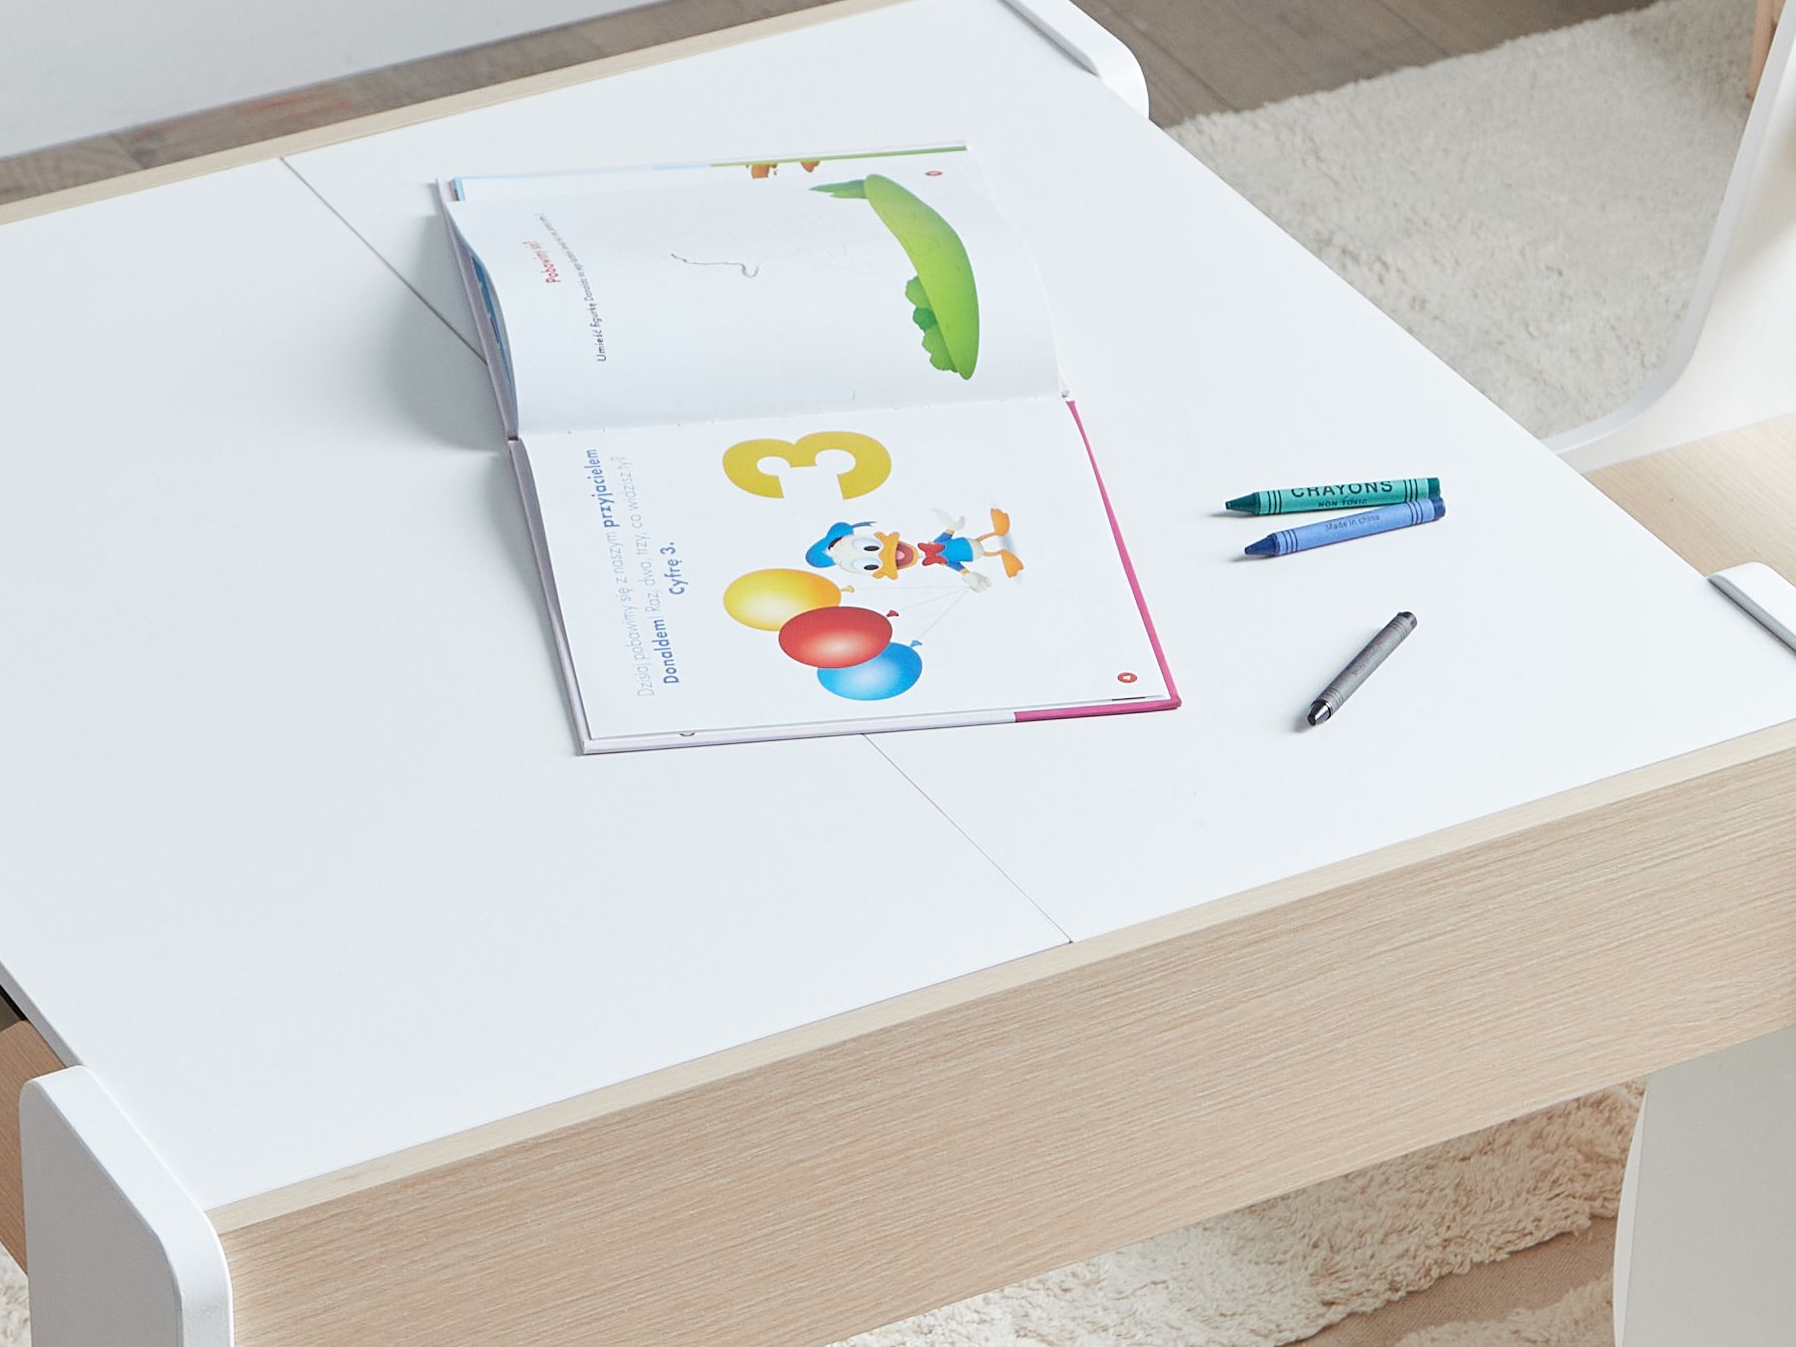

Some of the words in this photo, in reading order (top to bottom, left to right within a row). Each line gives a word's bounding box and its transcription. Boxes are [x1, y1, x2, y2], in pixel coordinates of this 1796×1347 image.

[722, 430, 892, 499] 3
[584, 448, 620, 528] przyjacielem
[1291, 480, 1393, 498] CRAYONS
[630, 514, 643, 529] co
[1325, 520, 1347, 530] Made
[1349, 519, 1355, 527] in
[659, 541, 676, 555] 3.
[664, 558, 689, 595] Cyfrę
